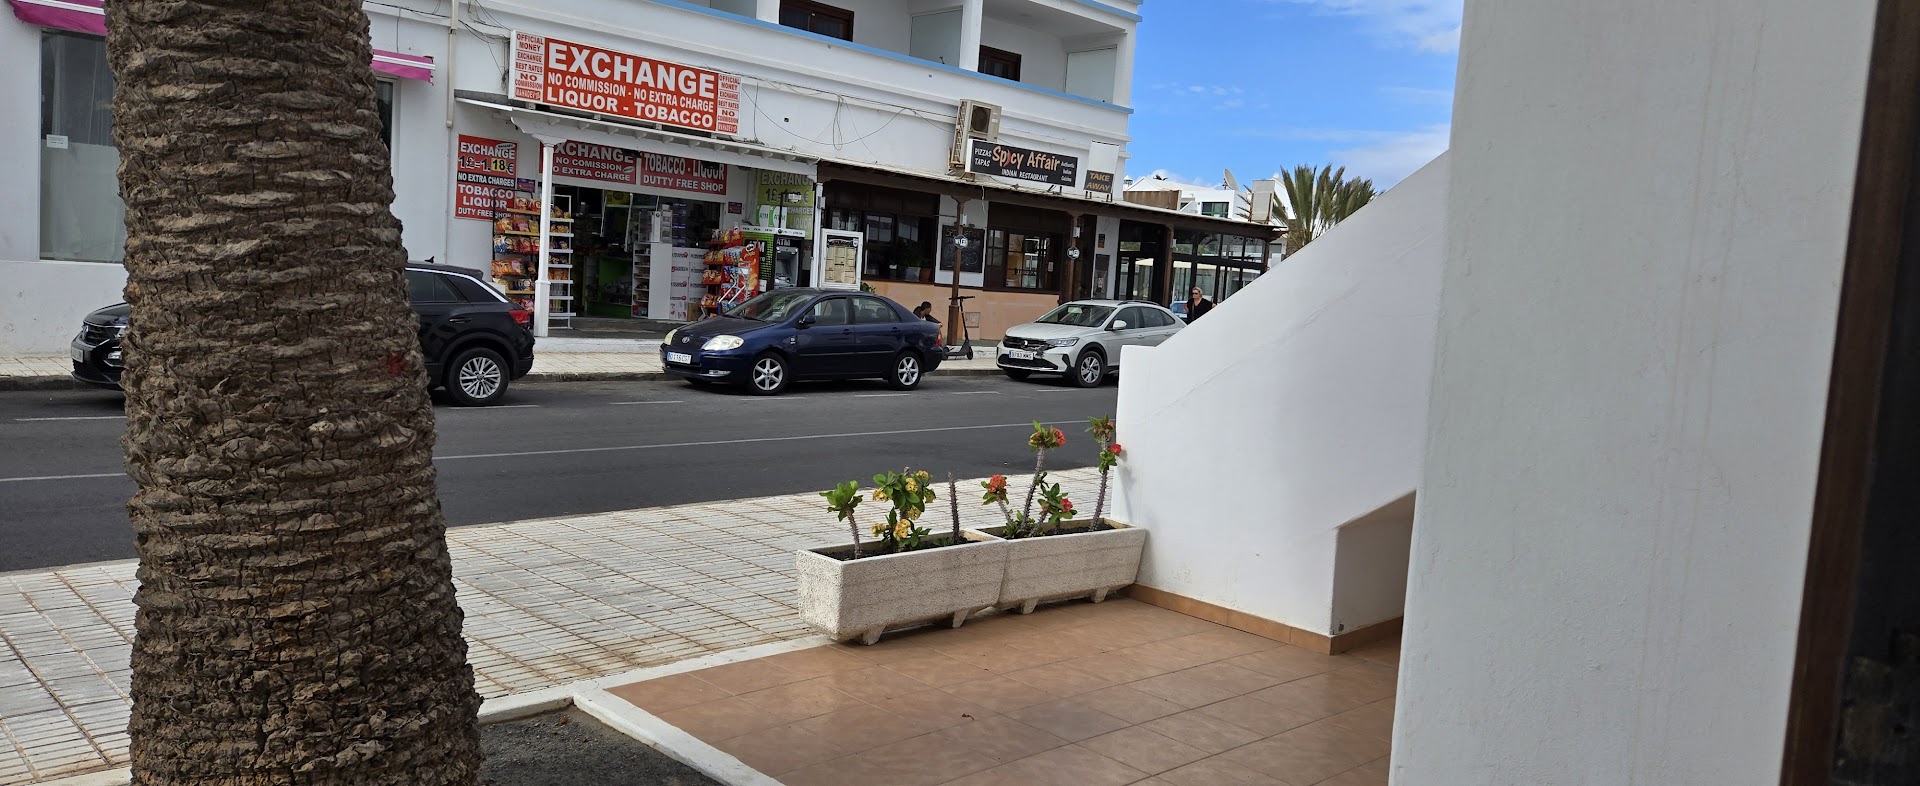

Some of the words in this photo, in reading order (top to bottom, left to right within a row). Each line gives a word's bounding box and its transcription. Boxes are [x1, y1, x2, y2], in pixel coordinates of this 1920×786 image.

[517, 34, 544, 44] OFFICIAL
[520, 42, 540, 52] MONEY
[518, 52, 542, 62] EXCHANGE
[516, 62, 527, 70] BEST
[528, 63, 542, 73] RATES
[549, 42, 714, 99] EXCHANGE
[521, 73, 537, 81] NO
[548, 72, 562, 86] NO
[565, 75, 626, 97] COMMISSION
[634, 88, 646, 100] NO
[650, 92, 677, 106] EXTRA
[680, 96, 714, 112] CHARGE
[547, 87, 618, 112] LIQUOR
[634, 102, 713, 128] TOBACCO
[461, 142, 515, 160] EXCHANGE
[554, 142, 633, 163] XCHANGE
[975, 148, 992, 157] PIZZAS
[572, 159, 622, 171] COMISSION
[975, 158, 990, 167] TAPAS
[992, 146, 1023, 169] Spicy
[1027, 151, 1060, 171] Affair
[644, 153, 685, 175] TOBACCO
[693, 160, 724, 180] LIQUOR
[458, 172, 466, 181] NO
[468, 174, 487, 184] EXTRA
[488, 176, 514, 187] CHARGES
[562, 168, 592, 176] EXTRA
[595, 171, 630, 181] CHARGE
[1002, 169, 1017, 177] INDIAN
[1020, 172, 1048, 182] RESTAURANT
[1090, 172, 1110, 182] TAKE
[644, 175, 673, 186] DUTTY
[676, 179, 698, 189] FREE
[701, 182, 723, 191] SHOP
[1086, 182, 1110, 191] AWAY
[458, 184, 514, 199] TOBACCO
[463, 196, 507, 209] LIQUOR
